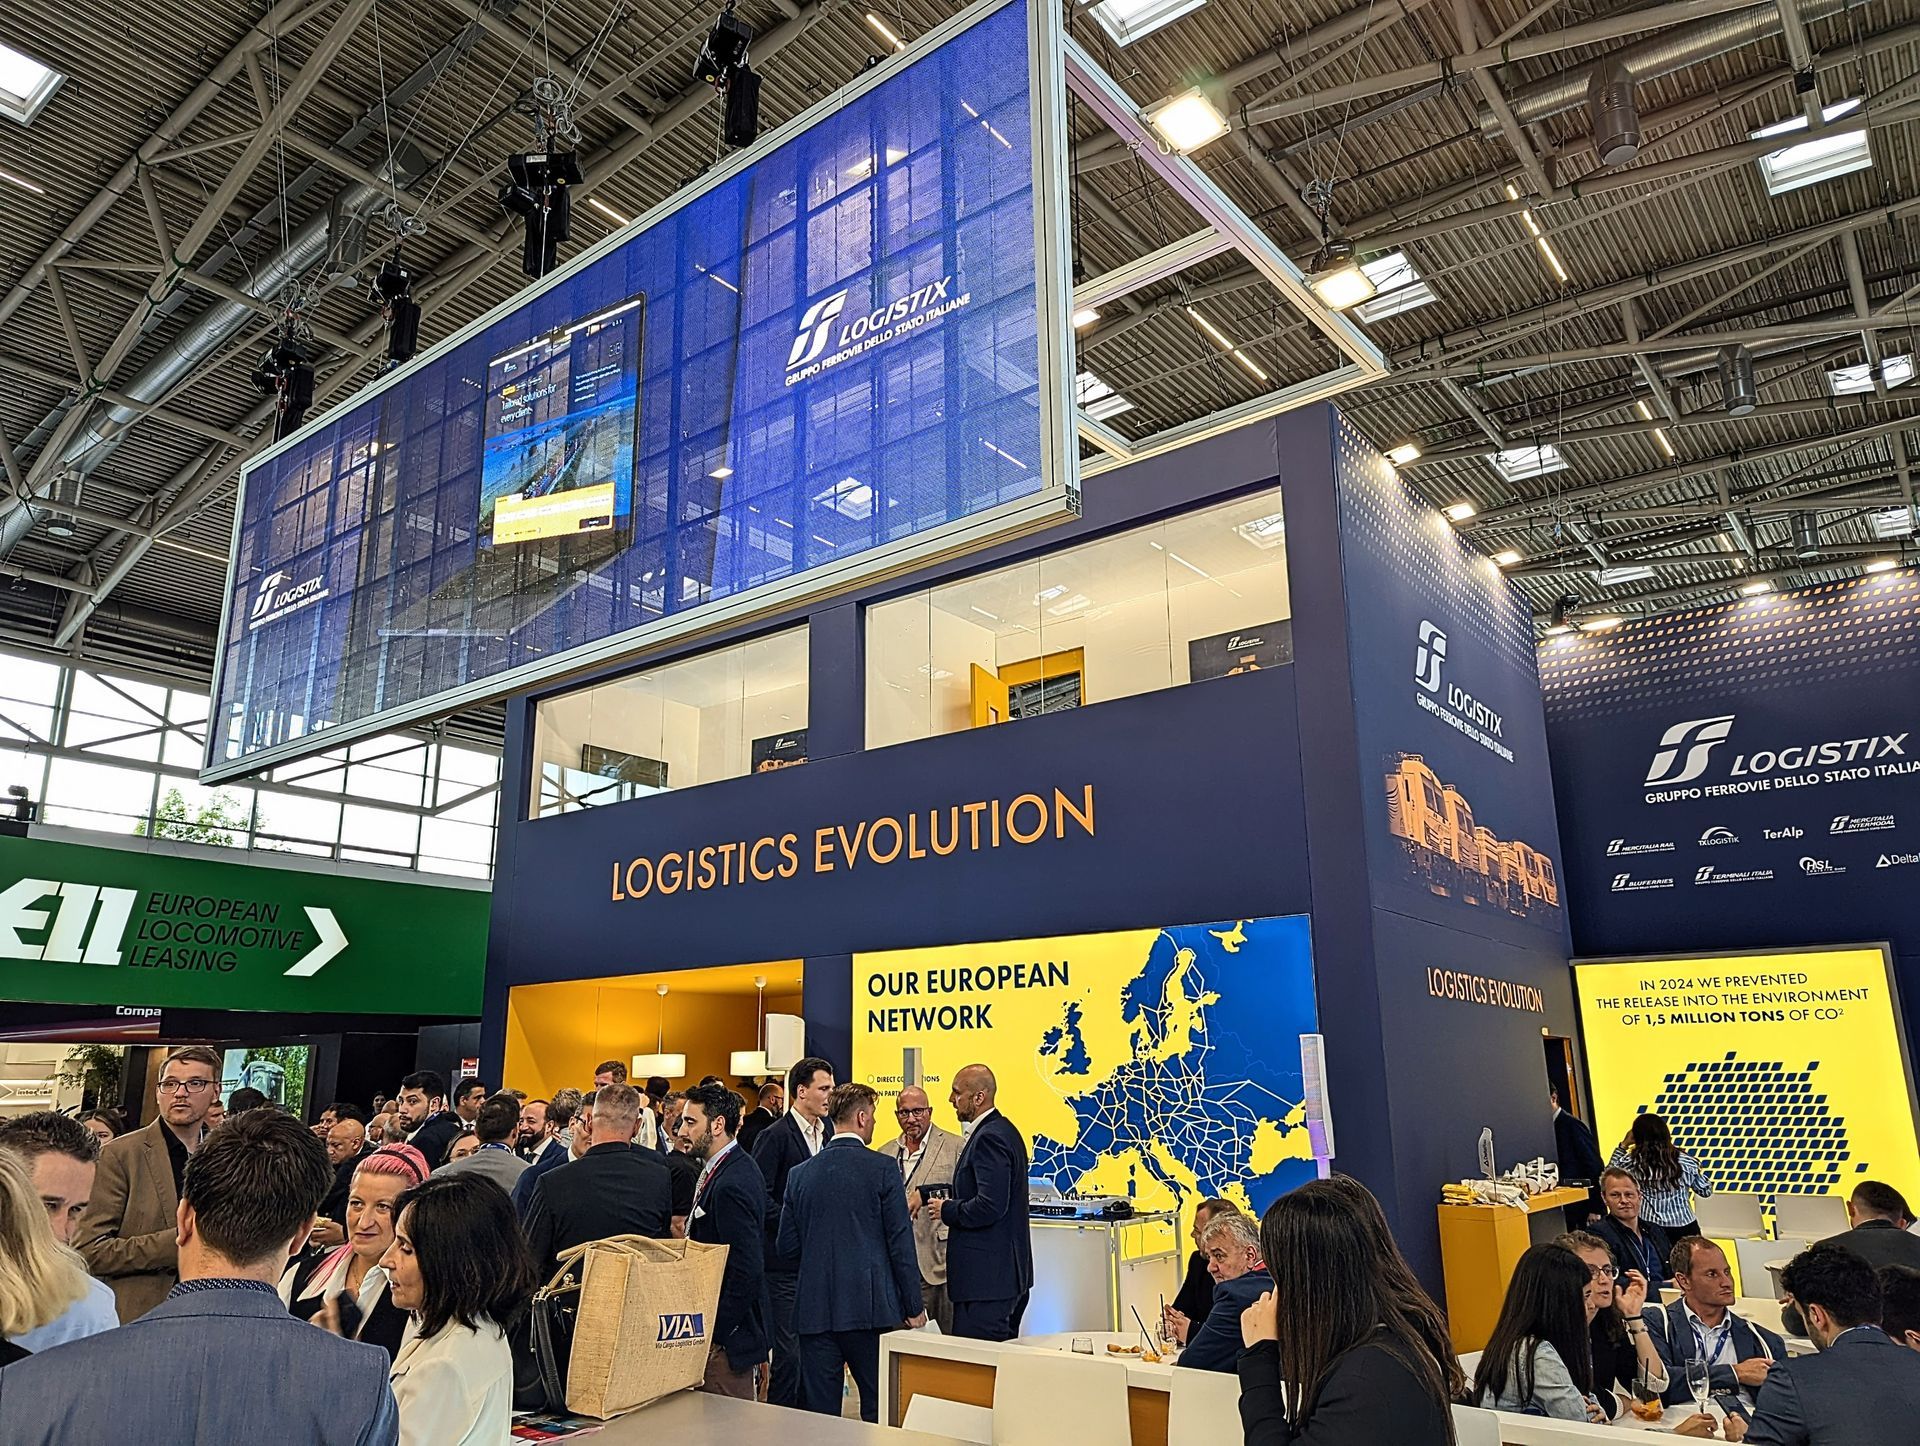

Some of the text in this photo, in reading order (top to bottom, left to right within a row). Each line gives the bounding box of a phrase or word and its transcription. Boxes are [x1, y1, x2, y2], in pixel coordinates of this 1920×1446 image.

[838, 276, 952, 347] LOGISTIX
[785, 292, 972, 387] GRUPPO FERROVIE DELLO STATO ITALIANE
[273, 574, 324, 609] LOGISTIX
[1447, 682, 1503, 738] LOGISTIX
[1730, 733, 1909, 776] LOGISTIX
[1645, 787, 1702, 805] GRUPPO
[1705, 778, 1772, 798] FERROVIE
[1775, 773, 1820, 790] DELLO
[1824, 767, 1871, 783] STATO
[1762, 826, 1804, 840] TerAlp
[1848, 819, 1895, 829] INTERMODAL
[1850, 814, 1895, 824] MERCITALIA
[611, 784, 1095, 901] LOGISTICS EVOLUTION
[1712, 871, 1751, 880] TERMINALI
[1806, 860, 1833, 871] HSL
[1629, 878, 1674, 887] BLUFERRIES
[146, 892, 280, 923] EUROPEAN
[137, 919, 304, 951] LOCOMOTIVE
[128, 946, 238, 972] LEASING
[867, 960, 1070, 998] OUR EUROPEAN
[1427, 966, 1544, 1013] LOGISTICS EVOLUTION
[1640, 973, 1808, 991] IN 2024 WE PREVENTED
[116, 1005, 162, 1018] Compa
[1596, 988, 1869, 1009] THE RELEASE INTO THE ENVIRONMENT
[867, 1003, 993, 1033] NETWORK
[1622, 1014, 1641, 1026] OF
[1645, 1014, 1666, 1027] 1,5
[1670, 1012, 1736, 1024] MILLION
[1740, 1010, 1785, 1023] TONS
[1789, 1009, 1810, 1021] OF
[675, 1340, 693, 1348] Logistics
